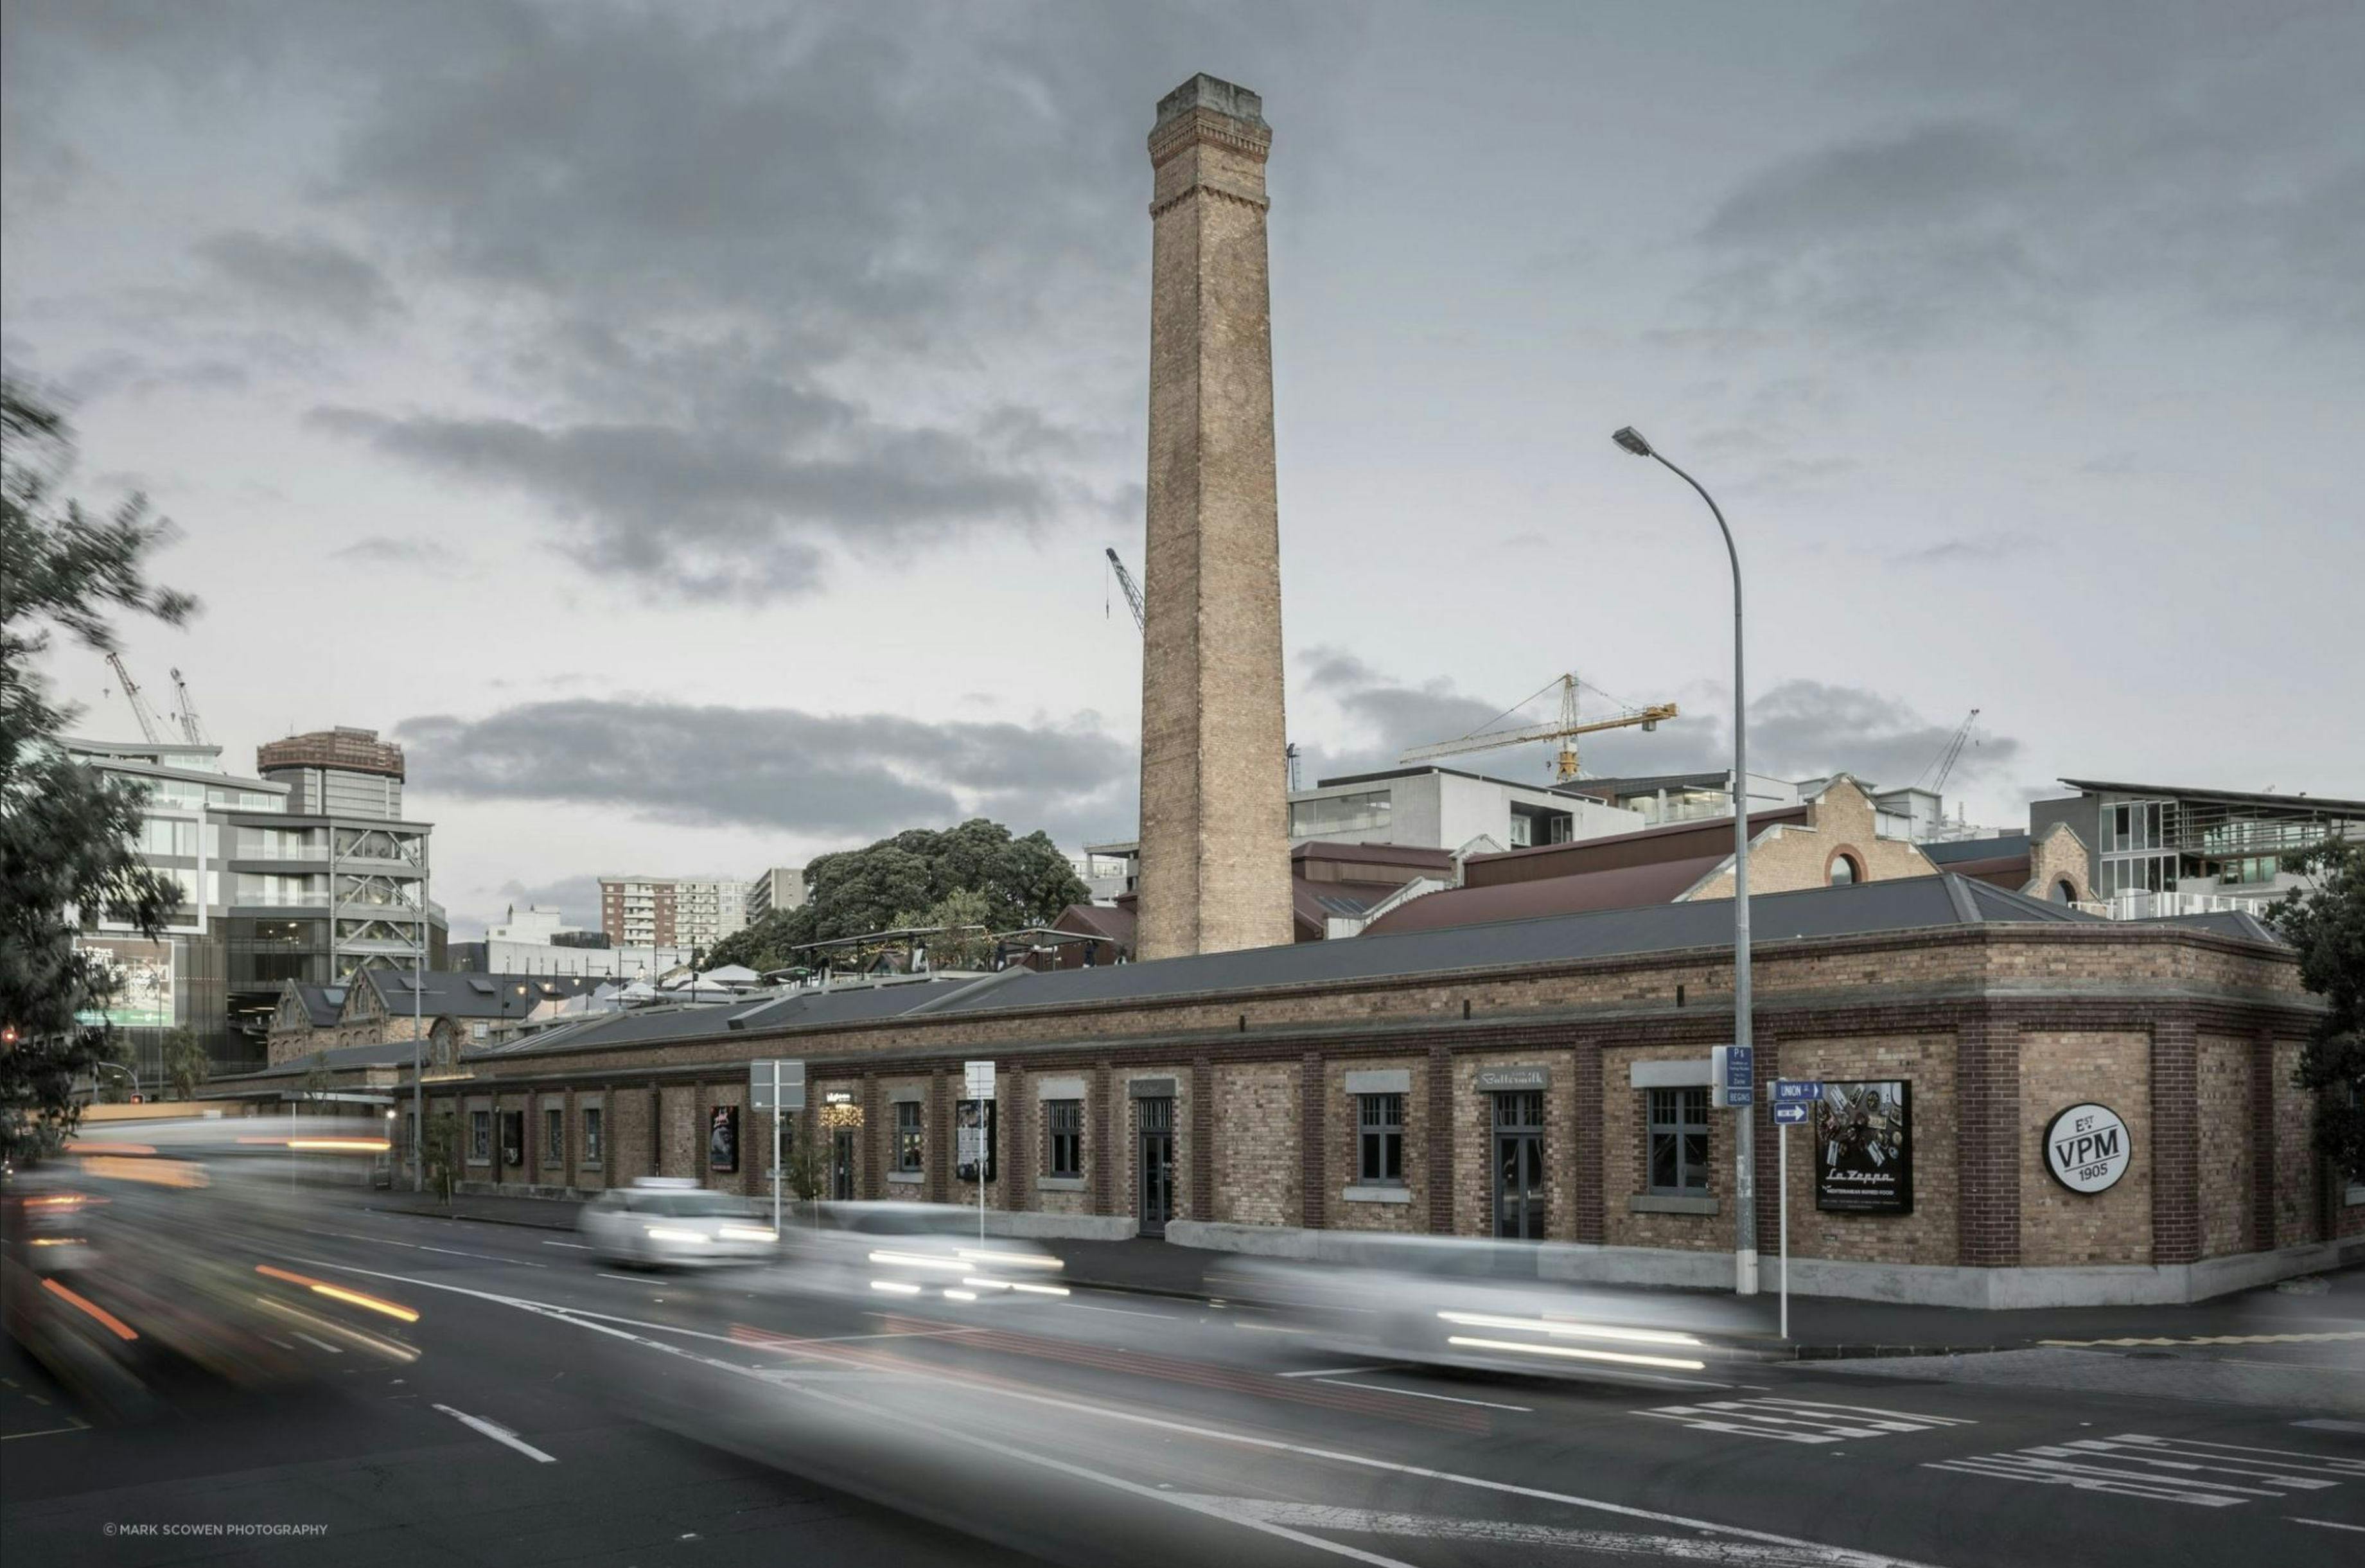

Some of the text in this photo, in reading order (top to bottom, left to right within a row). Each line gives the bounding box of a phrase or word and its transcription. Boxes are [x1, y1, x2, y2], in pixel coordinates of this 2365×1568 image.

[1734, 1048, 1739, 1059] P
[1481, 1071, 1543, 1085] Buttermilk
[1730, 1093, 1750, 1102] BEGINS
[1780, 1084, 1801, 1097] UNION
[2055, 1129, 2119, 1168] VPM
[1825, 1168, 1895, 1185] La Zeppa
[2079, 1163, 2108, 1181] 1905
